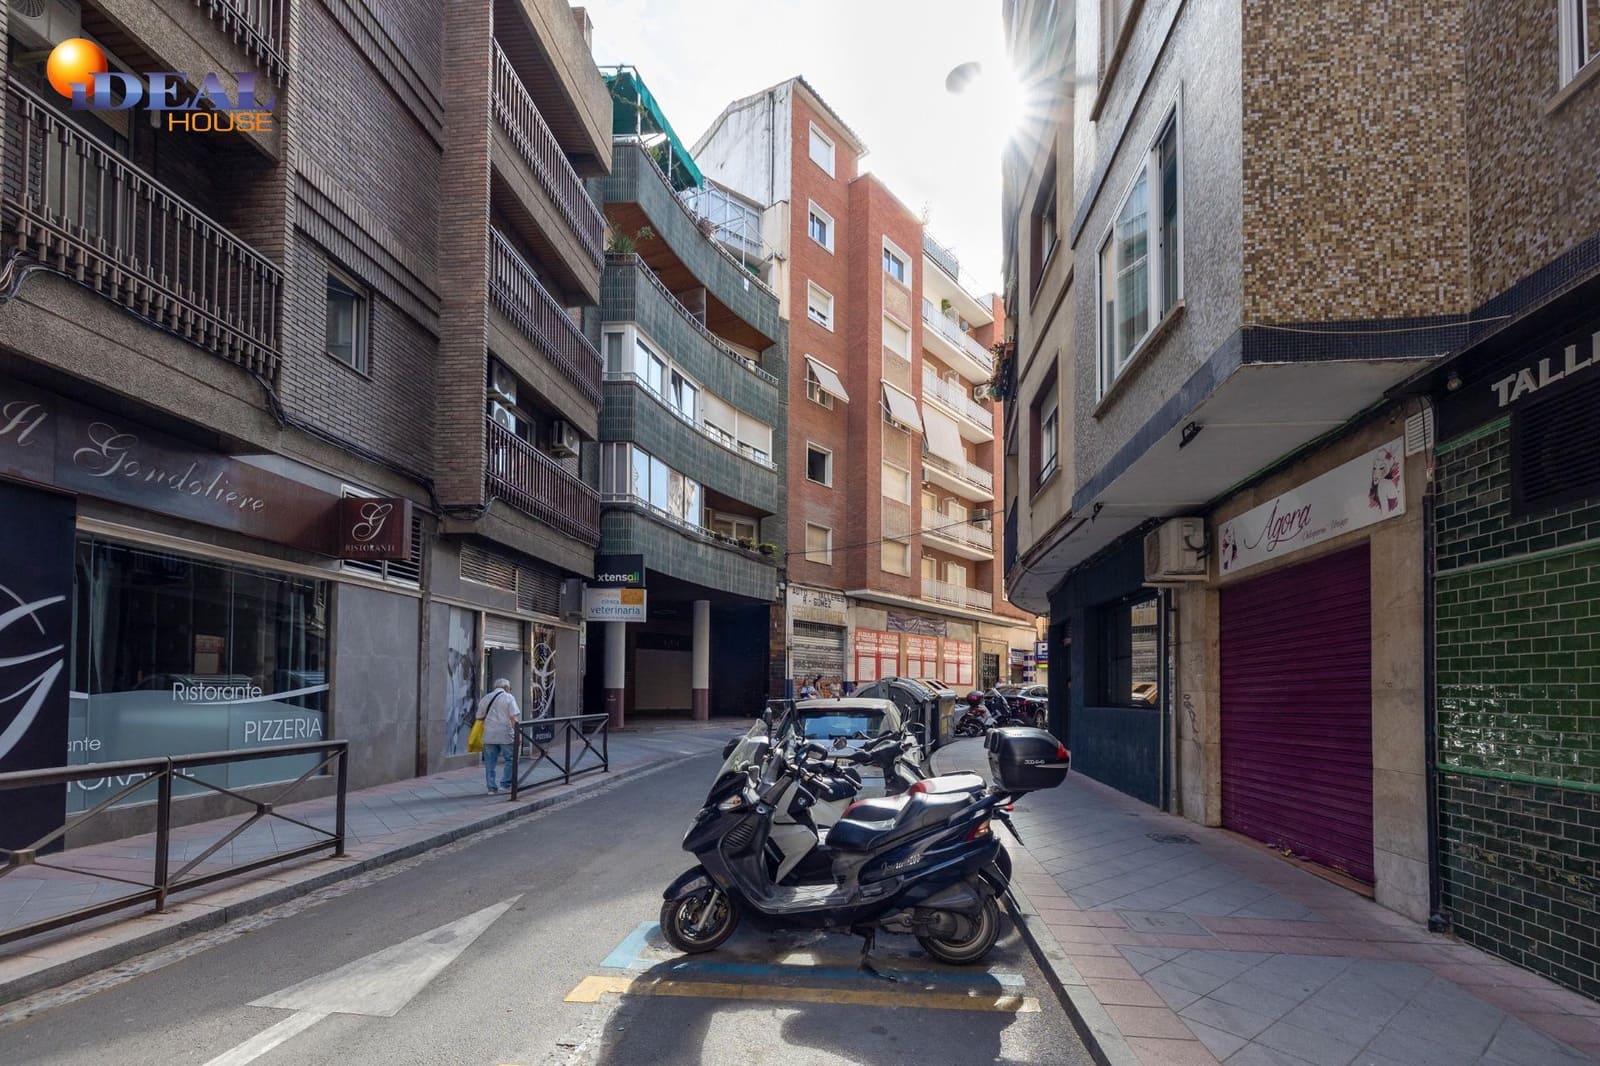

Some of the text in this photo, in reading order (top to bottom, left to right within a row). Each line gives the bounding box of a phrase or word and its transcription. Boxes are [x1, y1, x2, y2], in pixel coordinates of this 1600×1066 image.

[73, 421, 265, 513] Gondoliere
[351, 502, 393, 542] G
[1244, 499, 1312, 552] Ágora
[590, 605, 641, 615] veterinaria
[172, 682, 263, 702] Ristorante
[244, 718, 323, 743] PIZZERIA
